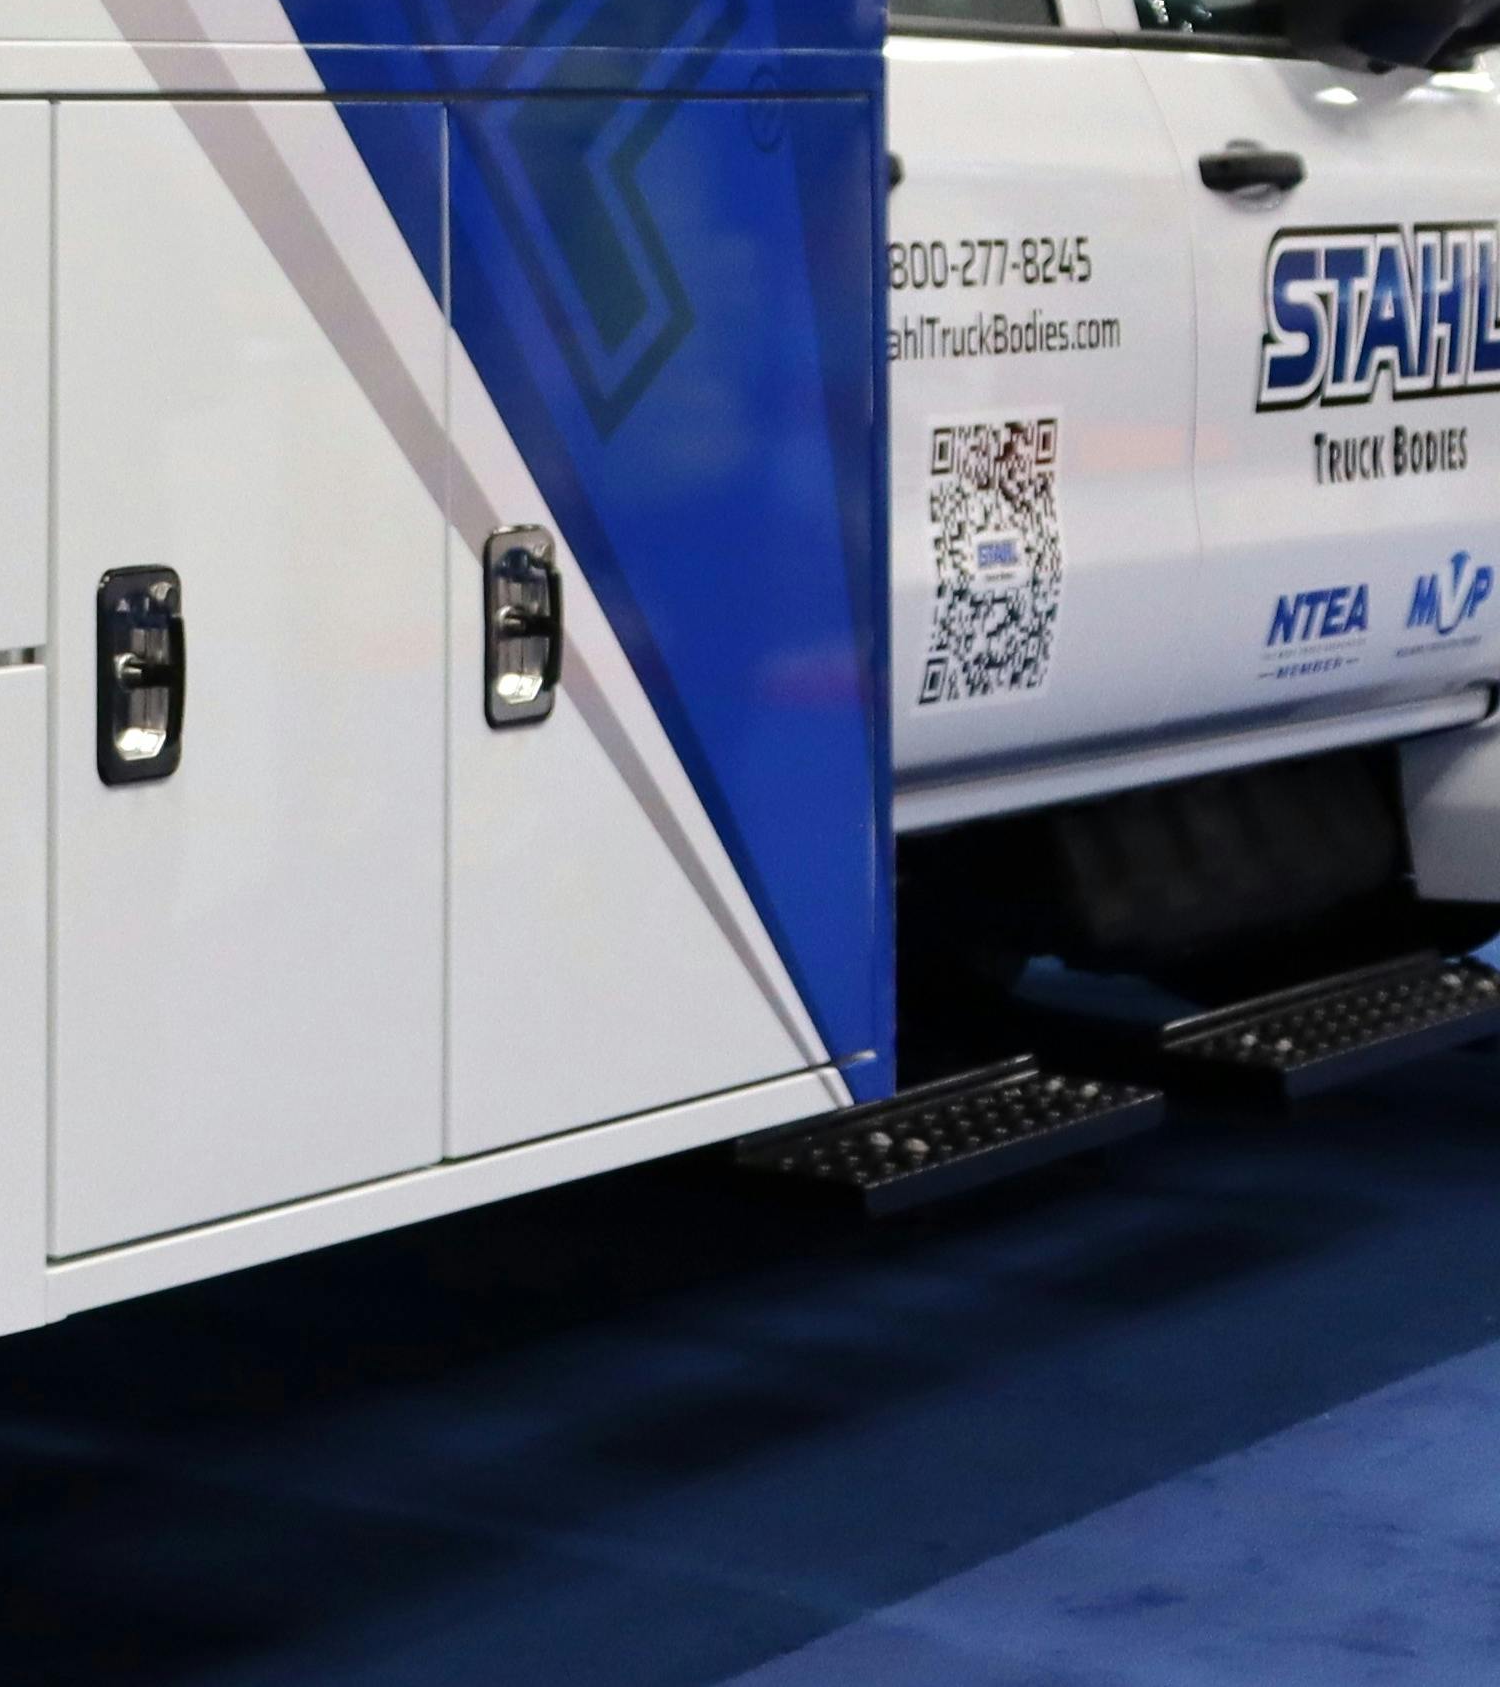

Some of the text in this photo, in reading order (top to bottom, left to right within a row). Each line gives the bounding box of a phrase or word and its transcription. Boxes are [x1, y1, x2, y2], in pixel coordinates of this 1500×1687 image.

[1313, 424, 1468, 484] TRUCK BODIES
[1265, 583, 1369, 647] NTEA
[1406, 549, 1494, 636] MVP
